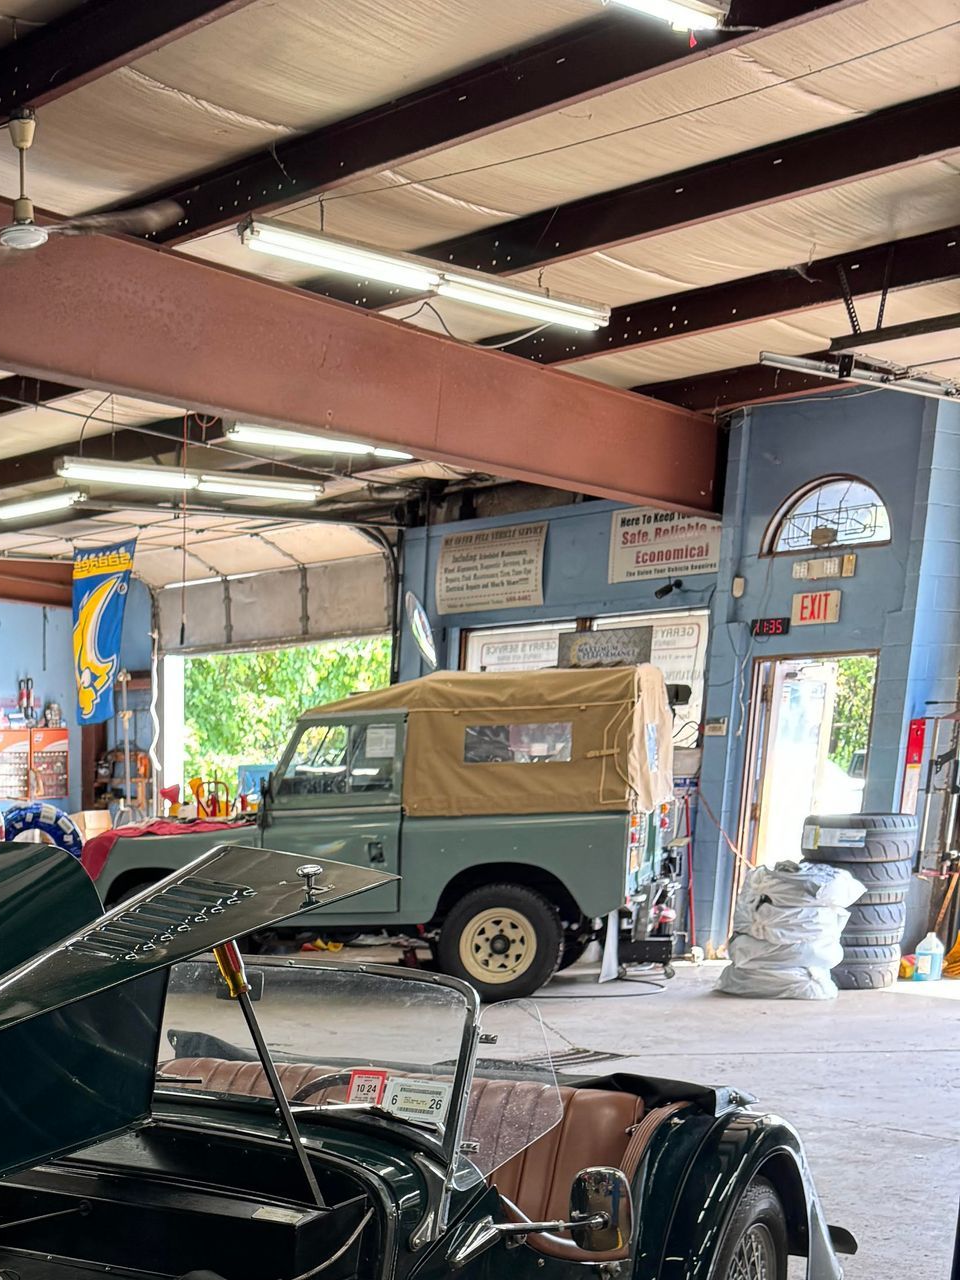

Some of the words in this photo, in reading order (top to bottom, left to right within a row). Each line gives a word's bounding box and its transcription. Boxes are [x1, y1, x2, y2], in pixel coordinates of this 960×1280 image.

[621, 516, 640, 527] Here
[643, 514, 652, 524] To
[654, 512, 675, 523] Keep
[654, 522, 707, 540] Reliable
[635, 543, 709, 564] Economical
[799, 593, 831, 621] EXIT
[356, 1084, 365, 1092] 10
[367, 1085, 376, 1093] 24
[391, 1095, 398, 1105] 6
[428, 1098, 443, 1110] 26
